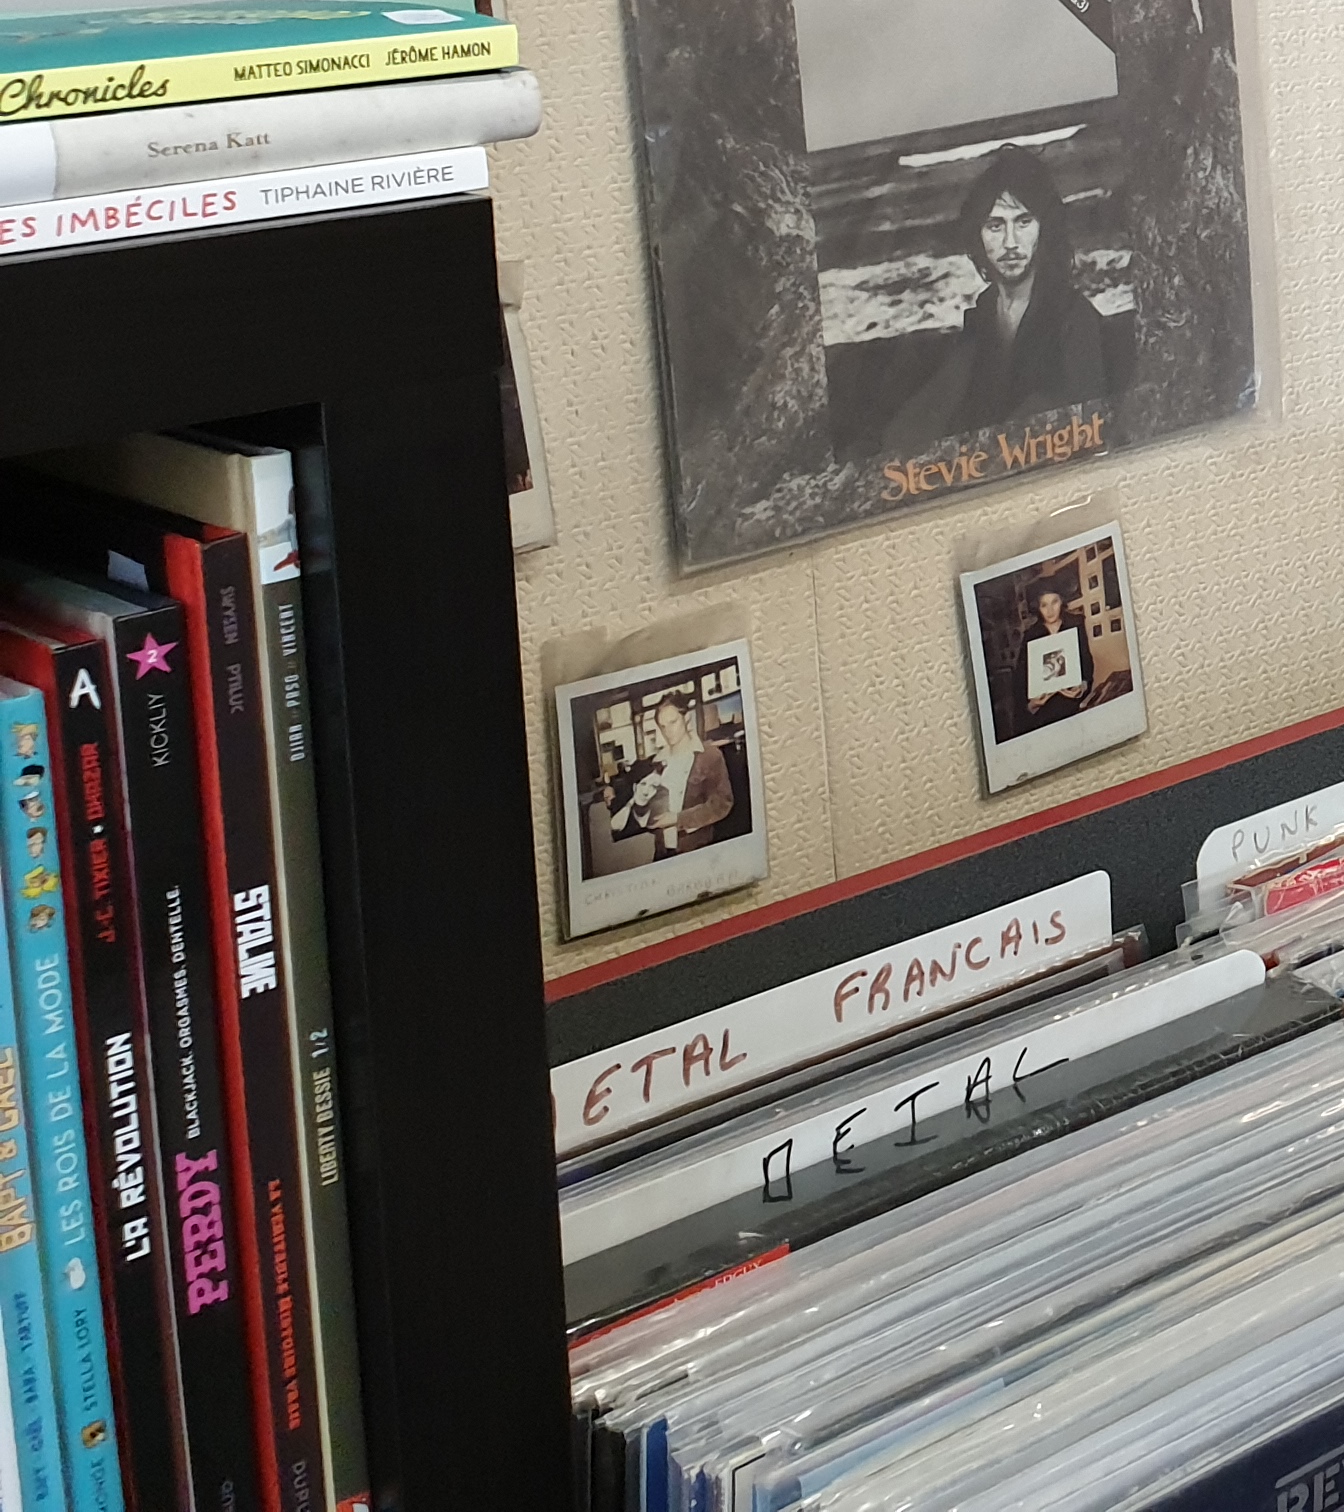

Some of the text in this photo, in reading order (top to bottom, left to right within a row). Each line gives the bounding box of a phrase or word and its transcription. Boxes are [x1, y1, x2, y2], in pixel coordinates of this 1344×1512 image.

[0, 42, 491, 117] Chronicles MATTEO SIMONACCI JÉRÔME HAMON
[146, 131, 271, 159] Serena Katt
[55, 190, 237, 237] IMBÉCILES
[260, 176, 365, 207] TIPHAINE
[370, 164, 454, 190] RIVIÈRE
[881, 413, 1105, 502] Stevie Wright
[69, 668, 101, 710] A
[147, 650, 158, 664] 2
[1231, 804, 1319, 861] PUNK
[233, 884, 277, 1001] STALINE
[556, 908, 1068, 1128] ETAL FRANCAIS
[37, 953, 86, 1247] LES ROIS DE LA MODE
[105, 1031, 146, 1210] RÉVOLUTION
[313, 1067, 334, 1123] BESSIE
[317, 1125, 340, 1186] LIBERTY
[176, 1150, 229, 1315] PERDY
